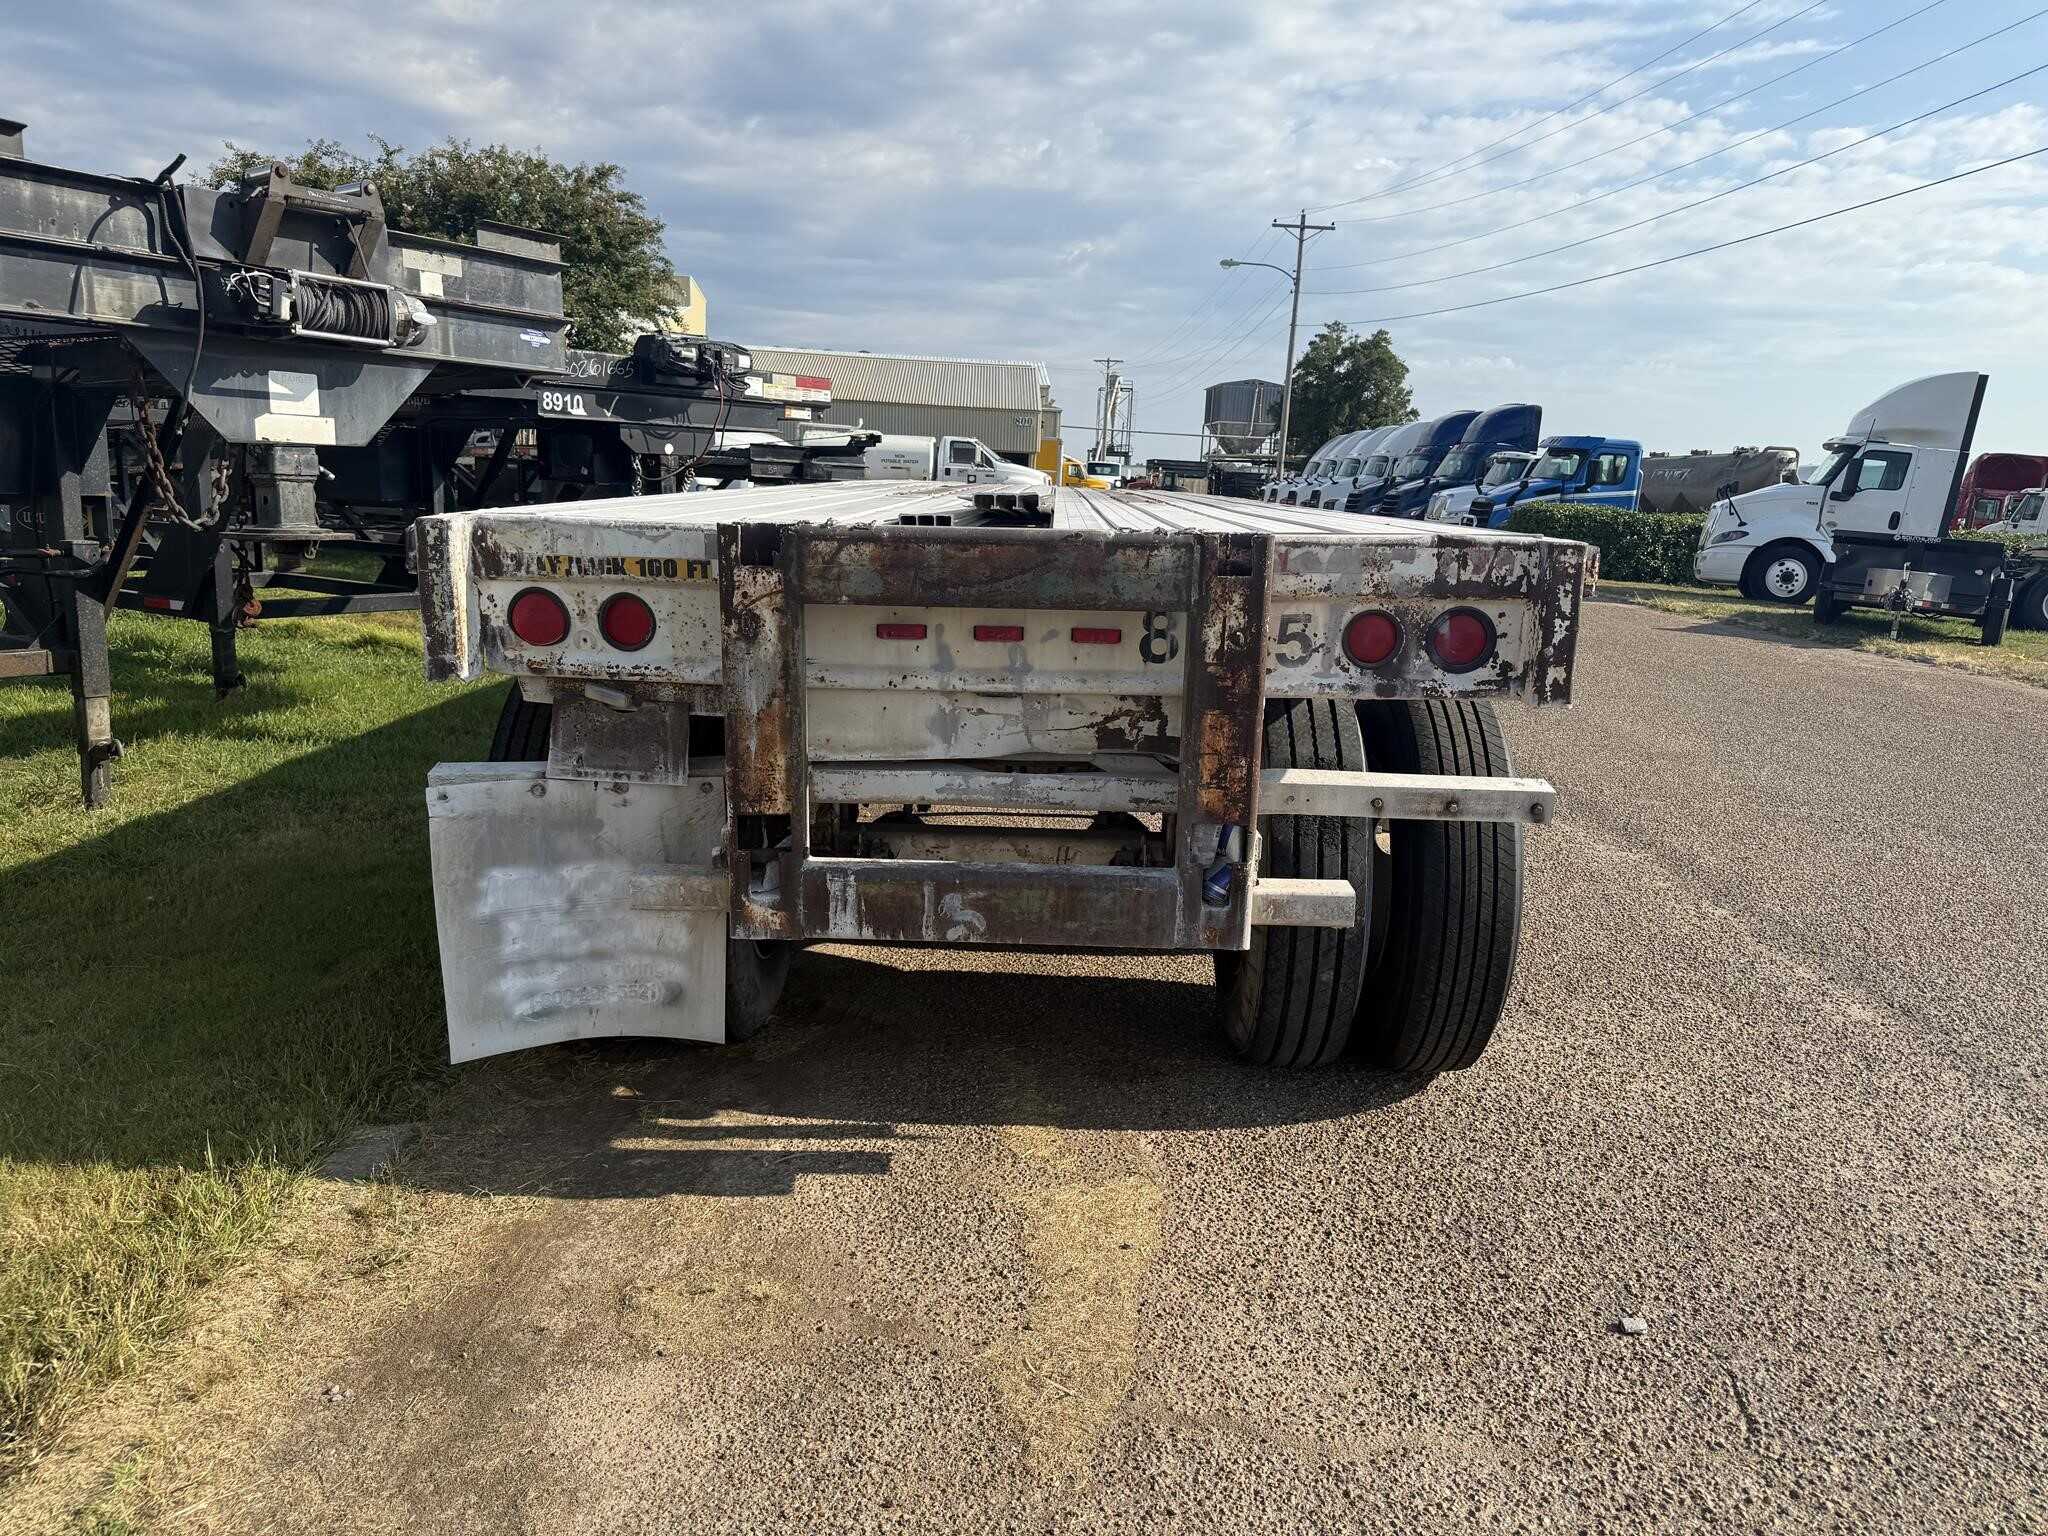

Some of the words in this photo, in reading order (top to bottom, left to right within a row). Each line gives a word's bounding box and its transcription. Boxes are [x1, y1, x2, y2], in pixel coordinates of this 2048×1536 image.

[542, 391, 587, 415] 8910
[635, 558, 678, 578] 100
[687, 560, 711, 579] FT
[1138, 611, 1179, 664] 8
[1275, 613, 1314, 669] 5
